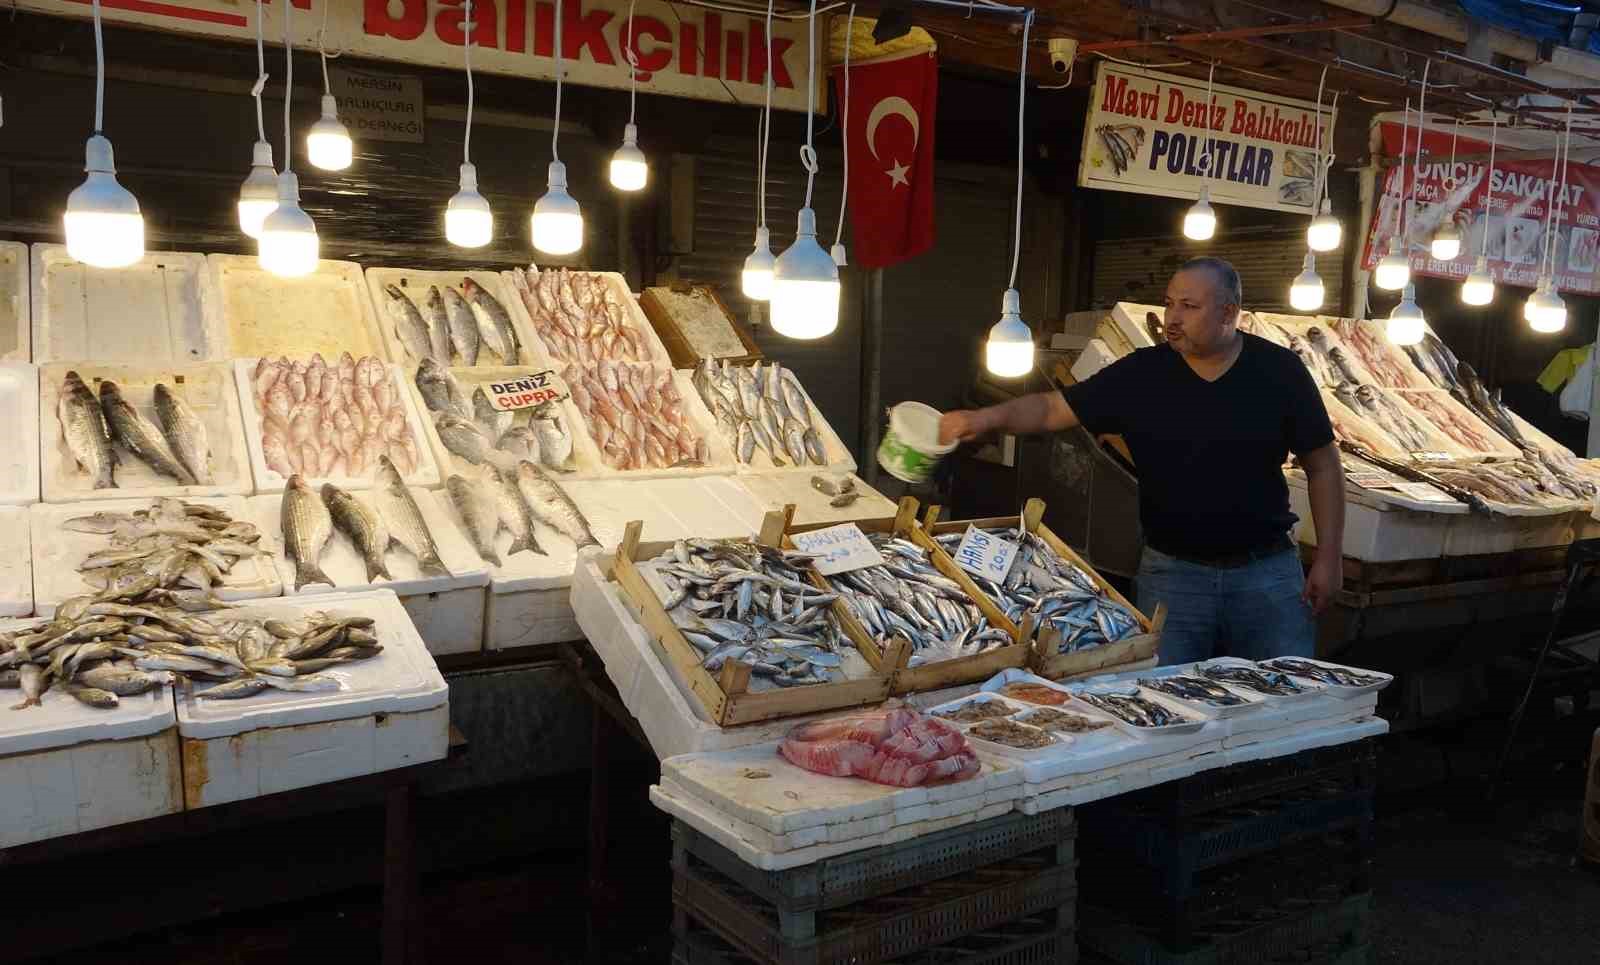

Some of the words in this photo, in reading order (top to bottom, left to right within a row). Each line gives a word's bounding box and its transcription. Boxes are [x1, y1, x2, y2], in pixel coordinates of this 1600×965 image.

[363, 0, 796, 89] balıkçılık
[1101, 75, 1160, 121] Mavi
[1164, 87, 1227, 131] Deniz
[1149, 130, 1274, 187] POLATLAR
[1490, 168, 1585, 208] SAKATAT
[498, 388, 559, 411] ÇUPRA
